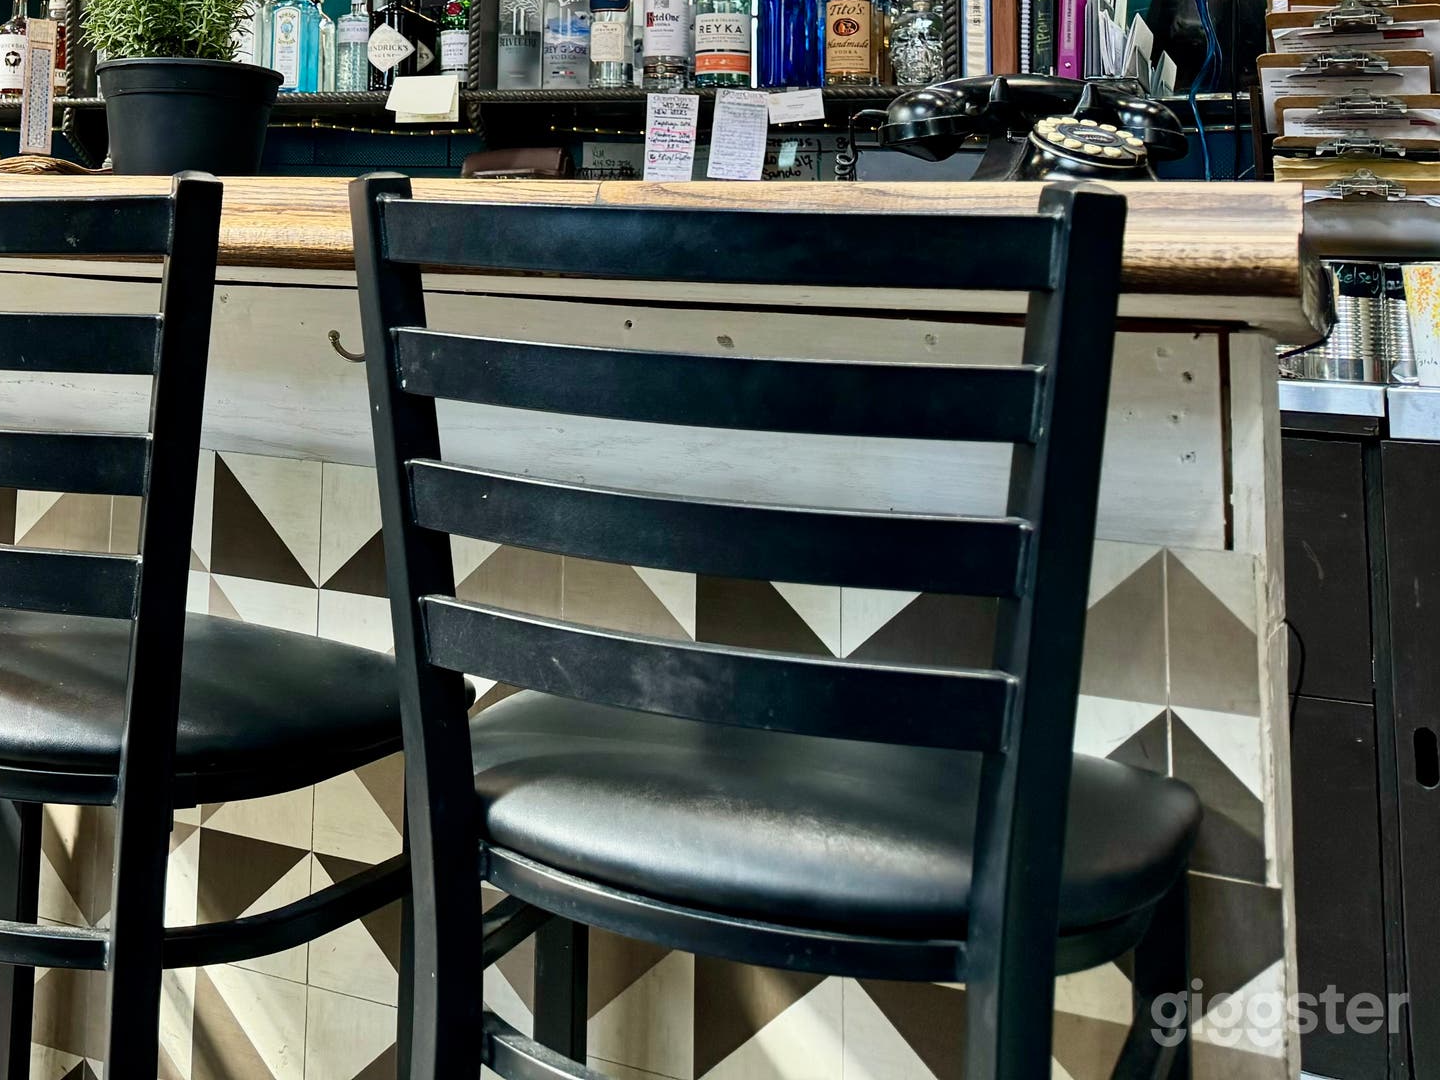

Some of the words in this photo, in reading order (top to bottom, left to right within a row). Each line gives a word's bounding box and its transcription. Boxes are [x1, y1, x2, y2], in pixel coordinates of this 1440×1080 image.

[829, 3, 865, 16] Tito's
[699, 24, 744, 34] REYKA
[827, 39, 869, 49] Handmade
